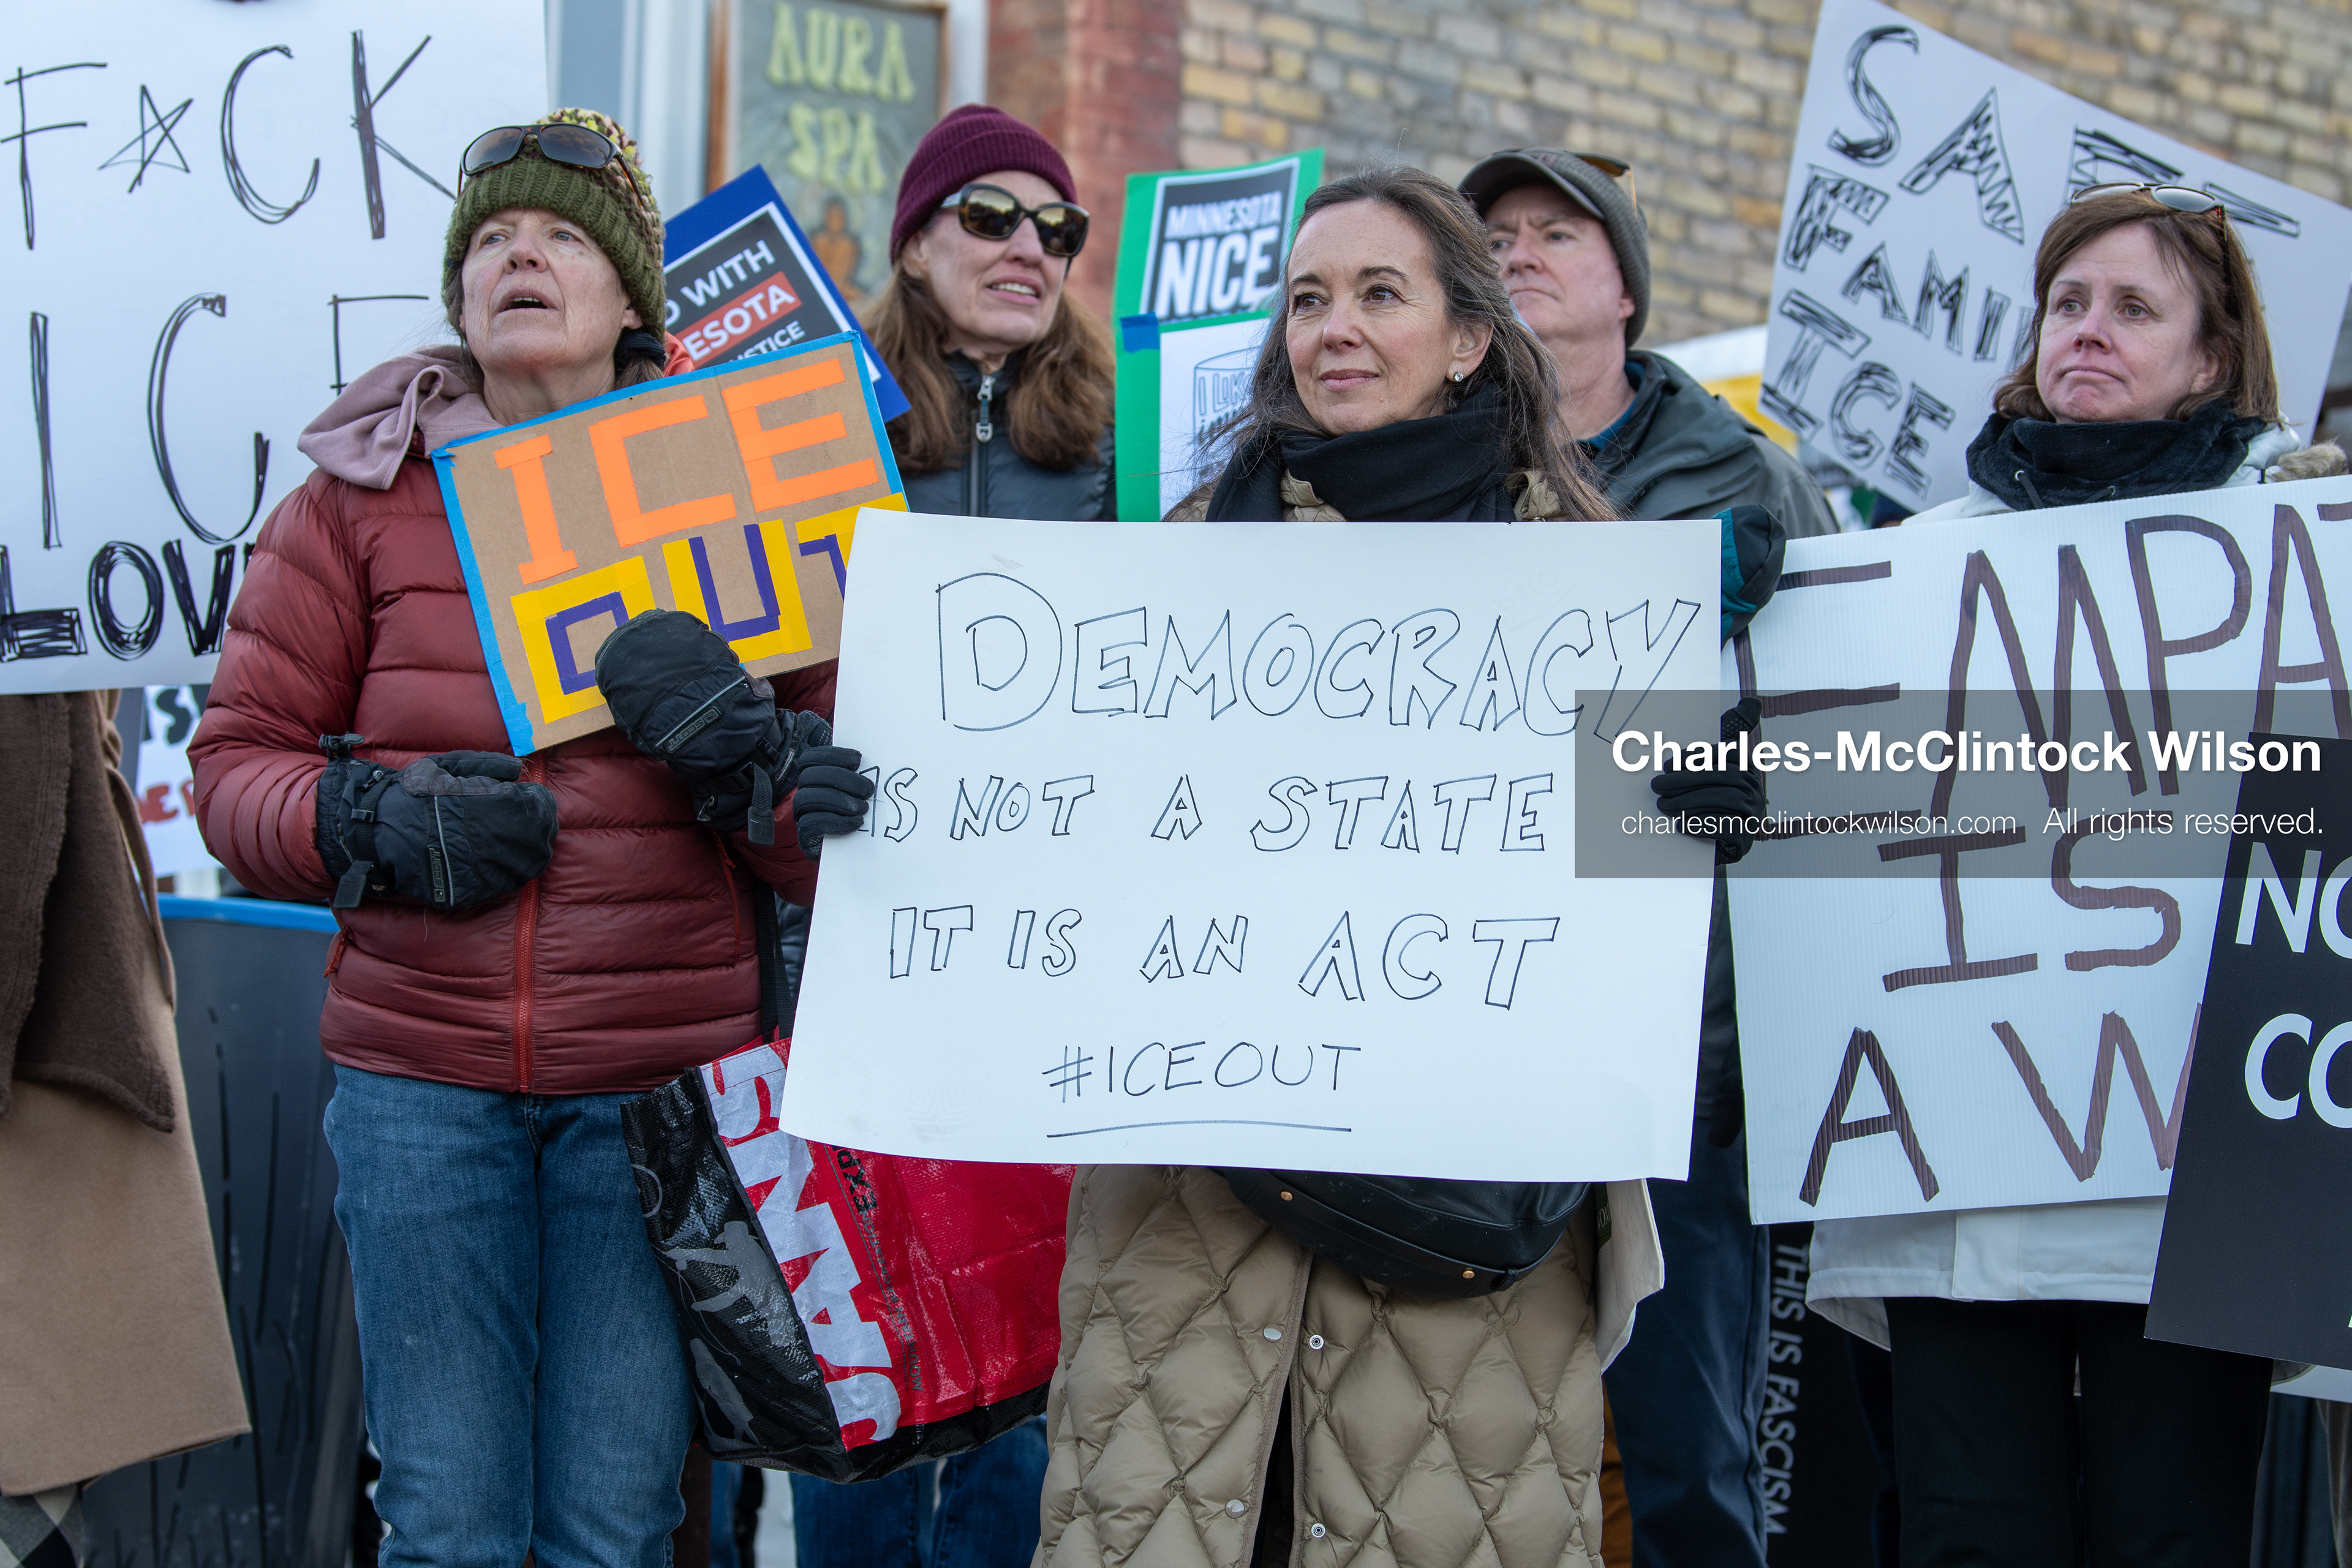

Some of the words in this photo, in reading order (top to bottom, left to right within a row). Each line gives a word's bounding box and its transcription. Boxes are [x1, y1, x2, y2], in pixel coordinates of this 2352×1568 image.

[767, 0, 915, 104] AURA
[786, 101, 887, 195] SPA
[1826, 24, 2301, 245] SAF
[1164, 190, 1283, 241] MINNESOTA
[680, 239, 776, 307] WITH
[1154, 224, 1281, 318] NICE
[682, 284, 797, 361] ESOTA
[729, 319, 805, 361] STICE
[1762, 288, 1956, 499] ICE
[493, 358, 879, 586] ICE
[0, 539, 255, 663] LOV
[935, 572, 1702, 745] DEMOCRACY
[1732, 499, 2352, 842] EMPA
[669, 717, 706, 752] SCOTT
[858, 766, 919, 843] IS
[950, 774, 1095, 840] NOT
[1151, 774, 1202, 840] A
[1250, 773, 1553, 855] STATE
[1877, 809, 2182, 993] IS
[890, 905, 974, 979] IT
[1007, 908, 1082, 977] IS
[1139, 914, 1248, 984] AN
[1298, 911, 1561, 1011] ACT
[1041, 1041, 1362, 1104] #ICEOUT
[1798, 1027, 1940, 1208] A
[1991, 1002, 2203, 1183] W
[832, 1144, 878, 1214] EXP
[1770, 1243, 1809, 1323] THIS
[1766, 1328, 1803, 1366] IS
[1759, 1373, 1800, 1535] FASCISM
